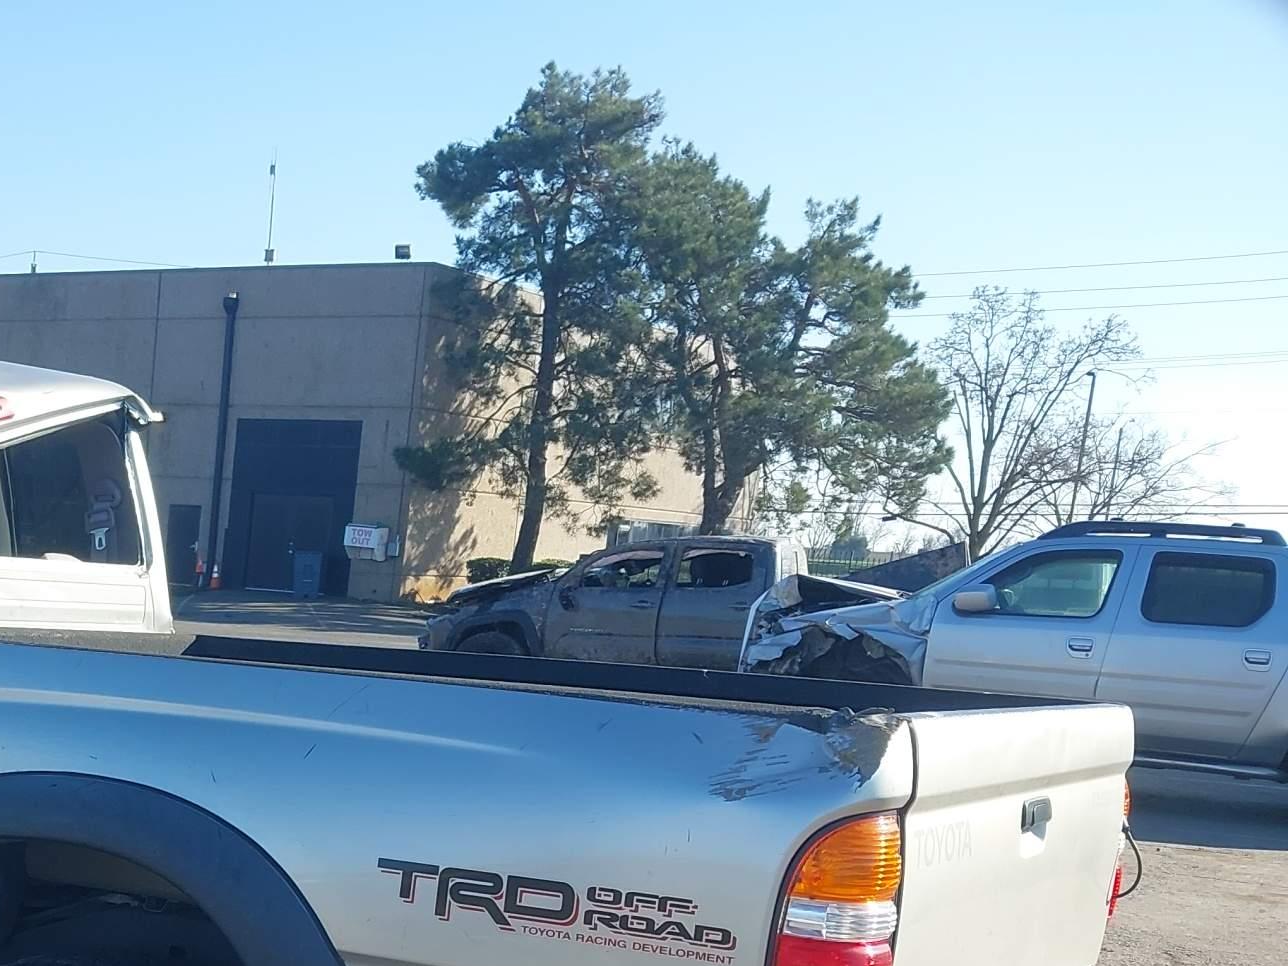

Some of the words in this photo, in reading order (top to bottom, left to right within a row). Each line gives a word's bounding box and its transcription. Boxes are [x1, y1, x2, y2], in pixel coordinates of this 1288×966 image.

[352, 528, 373, 538] TOW
[352, 537, 371, 546] OUT
[914, 819, 973, 868] TOYOTA
[377, 857, 579, 932] TRD
[520, 924, 572, 942] TOYOTA
[574, 932, 628, 950] RACING
[631, 940, 736, 966] DEVELOPMENT
[583, 909, 737, 951] ROAD
